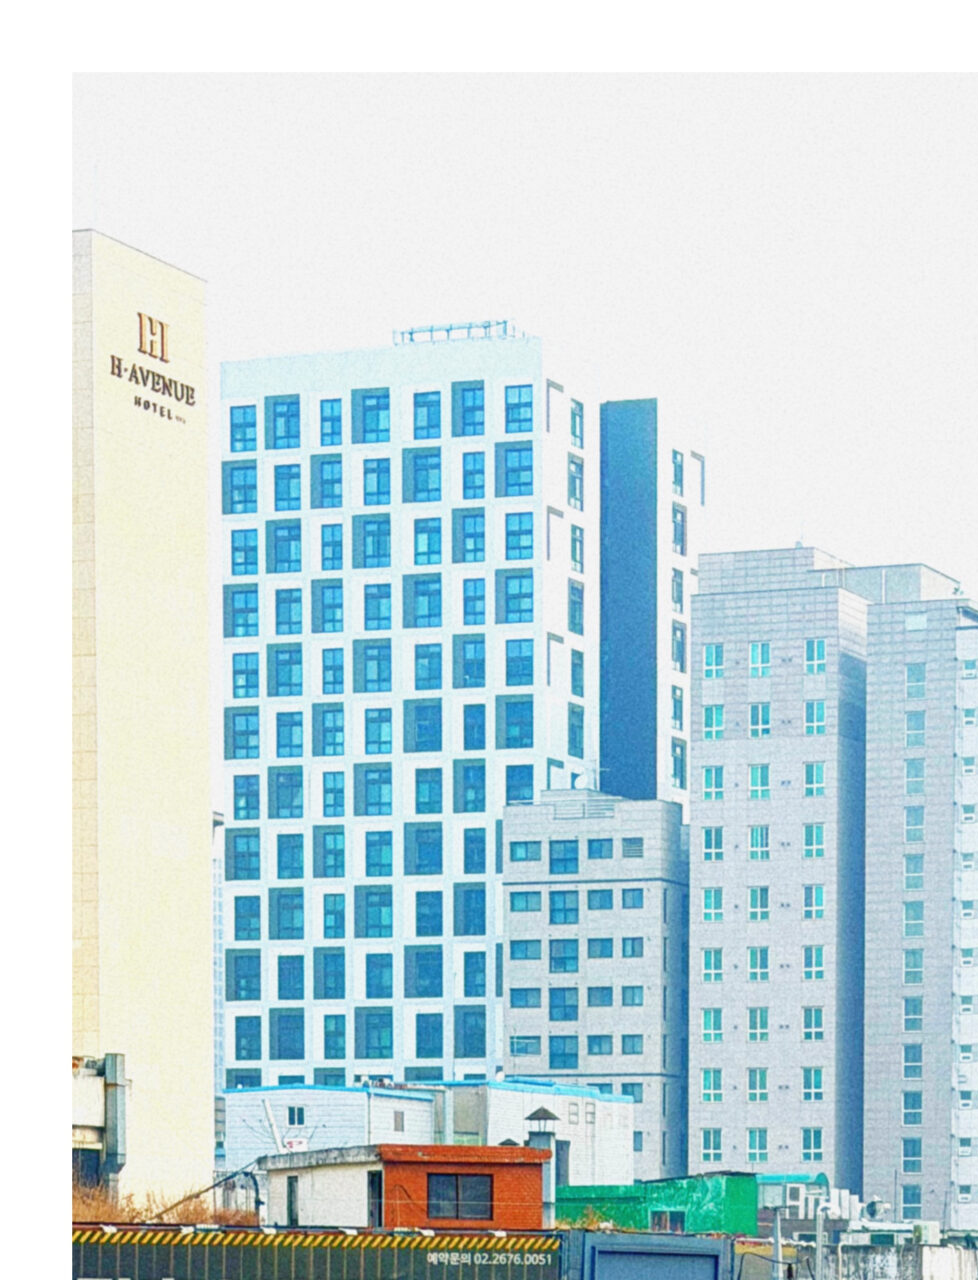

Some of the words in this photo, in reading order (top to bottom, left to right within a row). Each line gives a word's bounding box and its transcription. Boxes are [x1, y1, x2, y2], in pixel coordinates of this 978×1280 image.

[137, 311, 170, 363] H
[134, 395, 173, 421] HOTEL
[426, 1252, 472, 1265] 예약문의
[474, 1253, 553, 1265] 02.2676.0051
